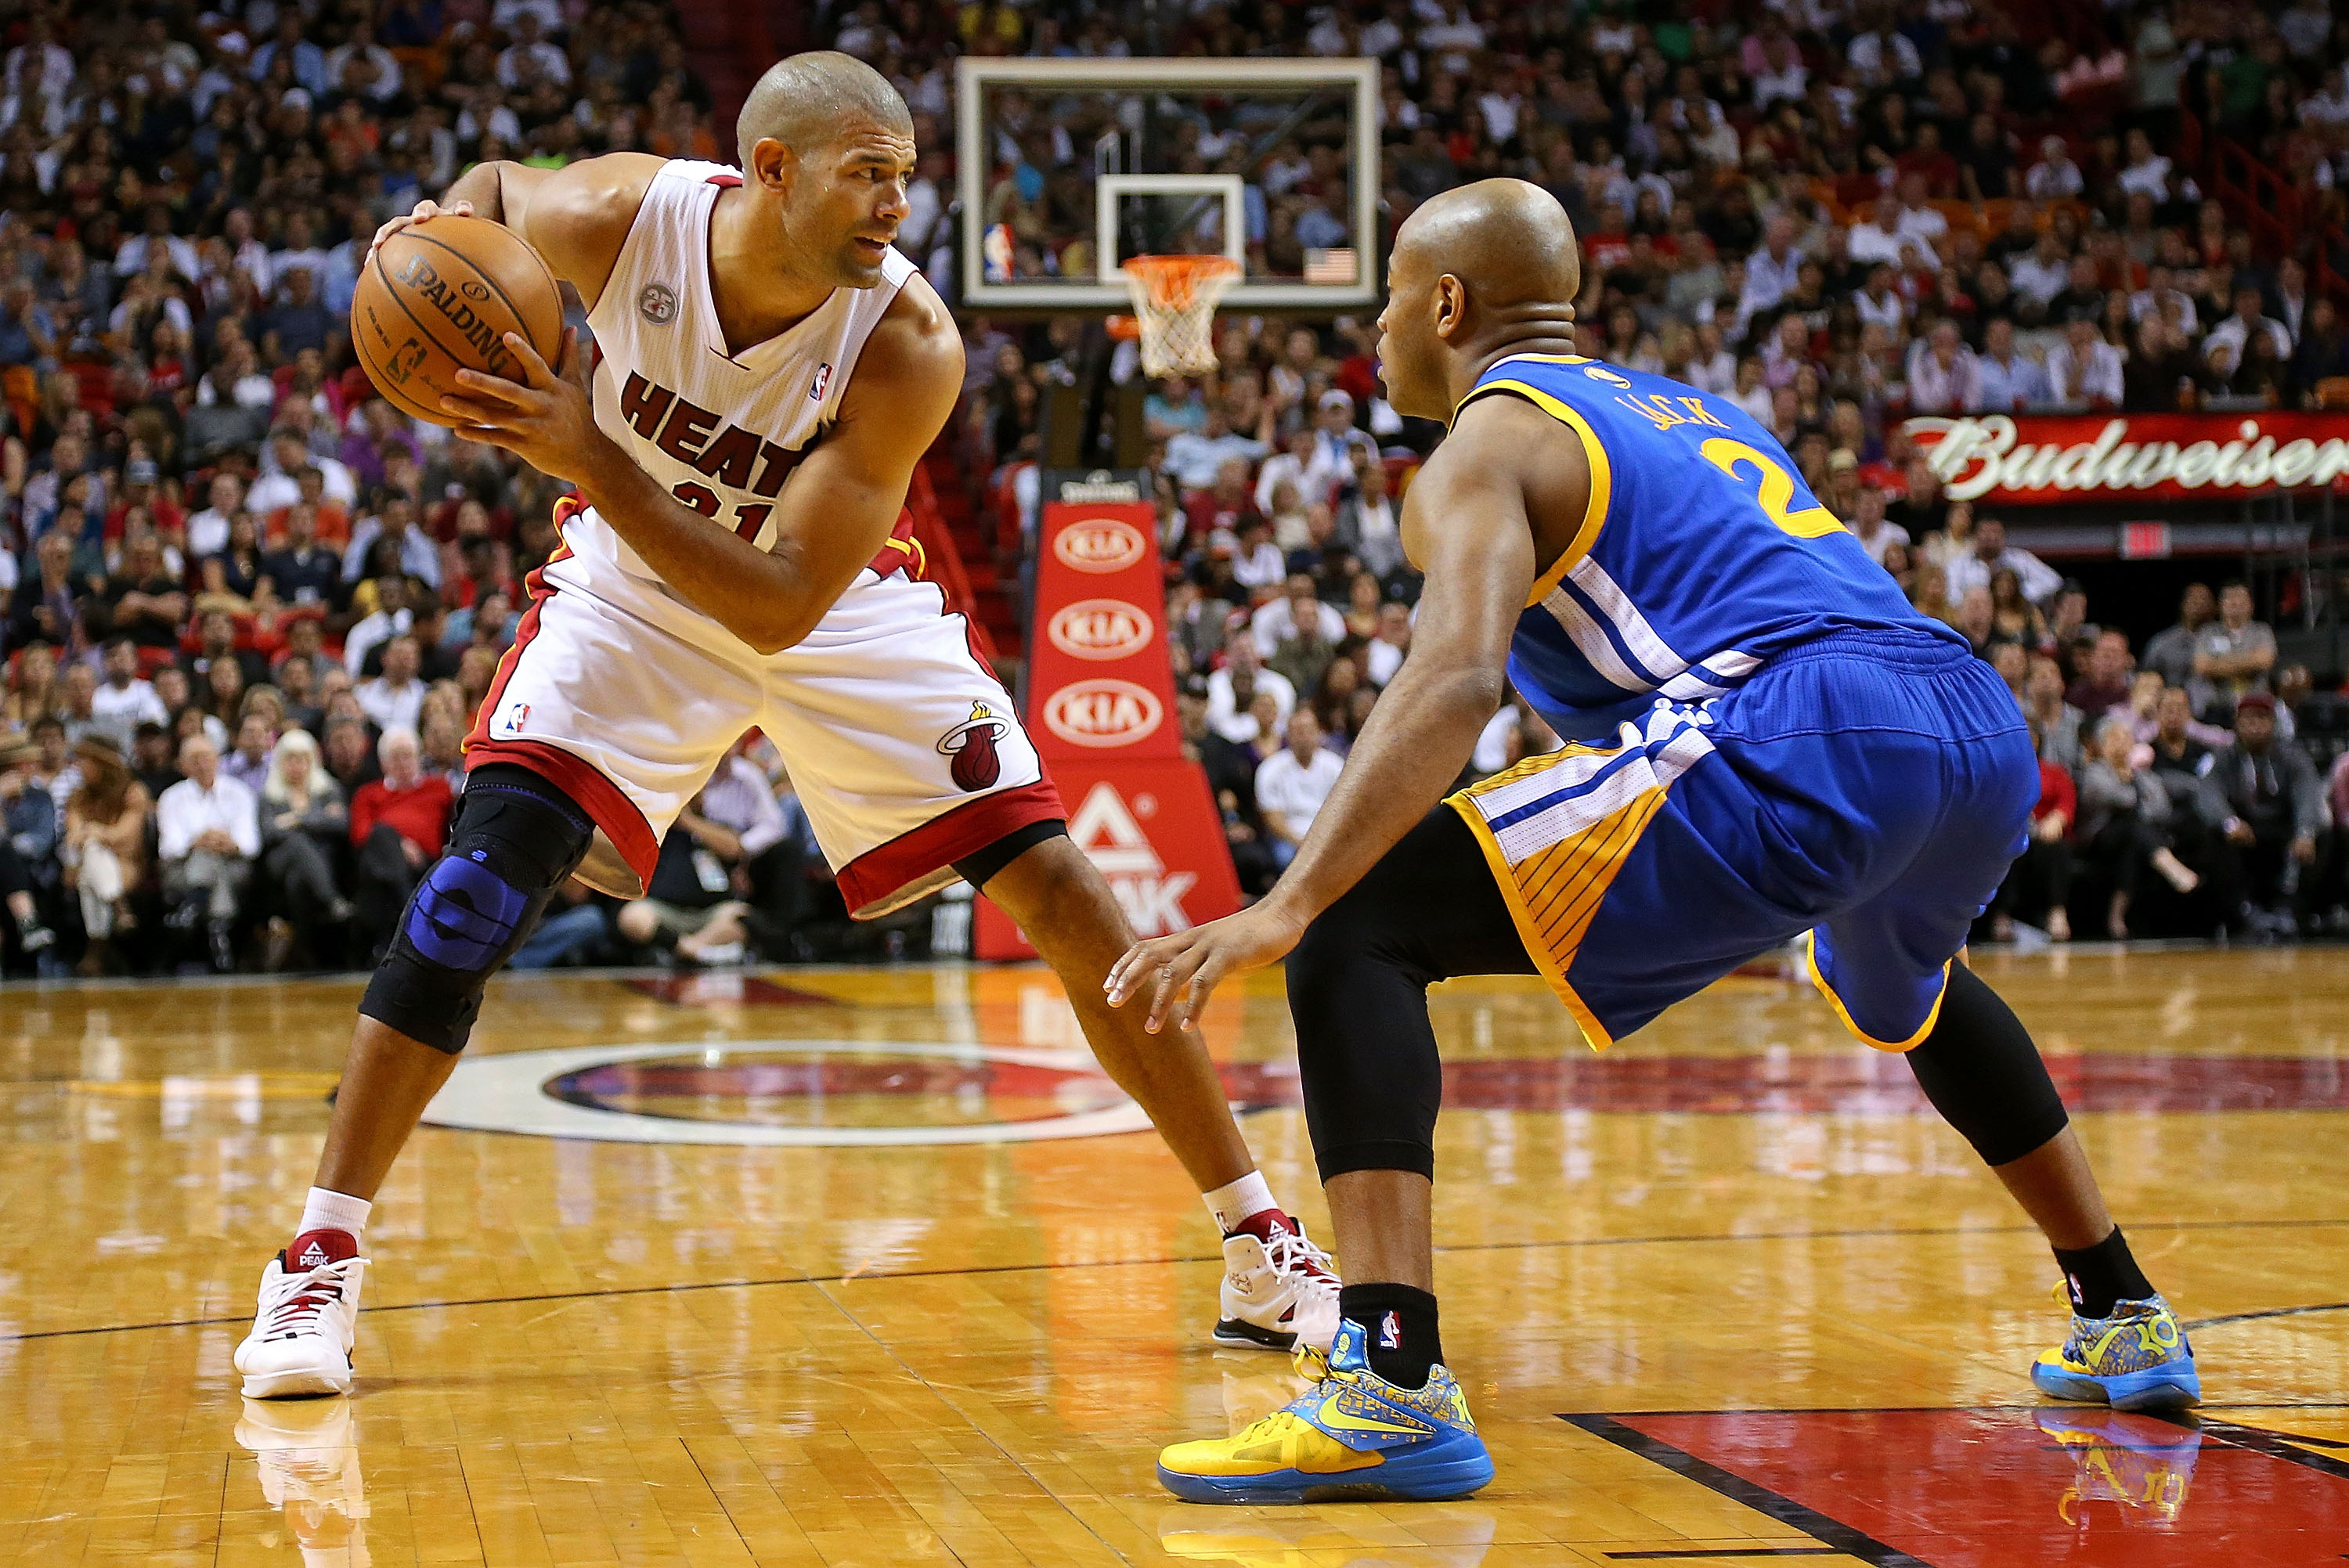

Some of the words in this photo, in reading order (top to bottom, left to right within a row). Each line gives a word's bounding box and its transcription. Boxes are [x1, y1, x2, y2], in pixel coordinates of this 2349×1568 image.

[395, 254, 513, 373] SPALDING
[643, 288, 676, 319] 25
[620, 369, 828, 499] HEAT
[1615, 394, 1731, 431] JACK
[1699, 438, 1853, 538] 2
[1903, 415, 2349, 501] Budweiser
[1063, 692, 1144, 734] KIA
[299, 1255, 330, 1267] PEAK
